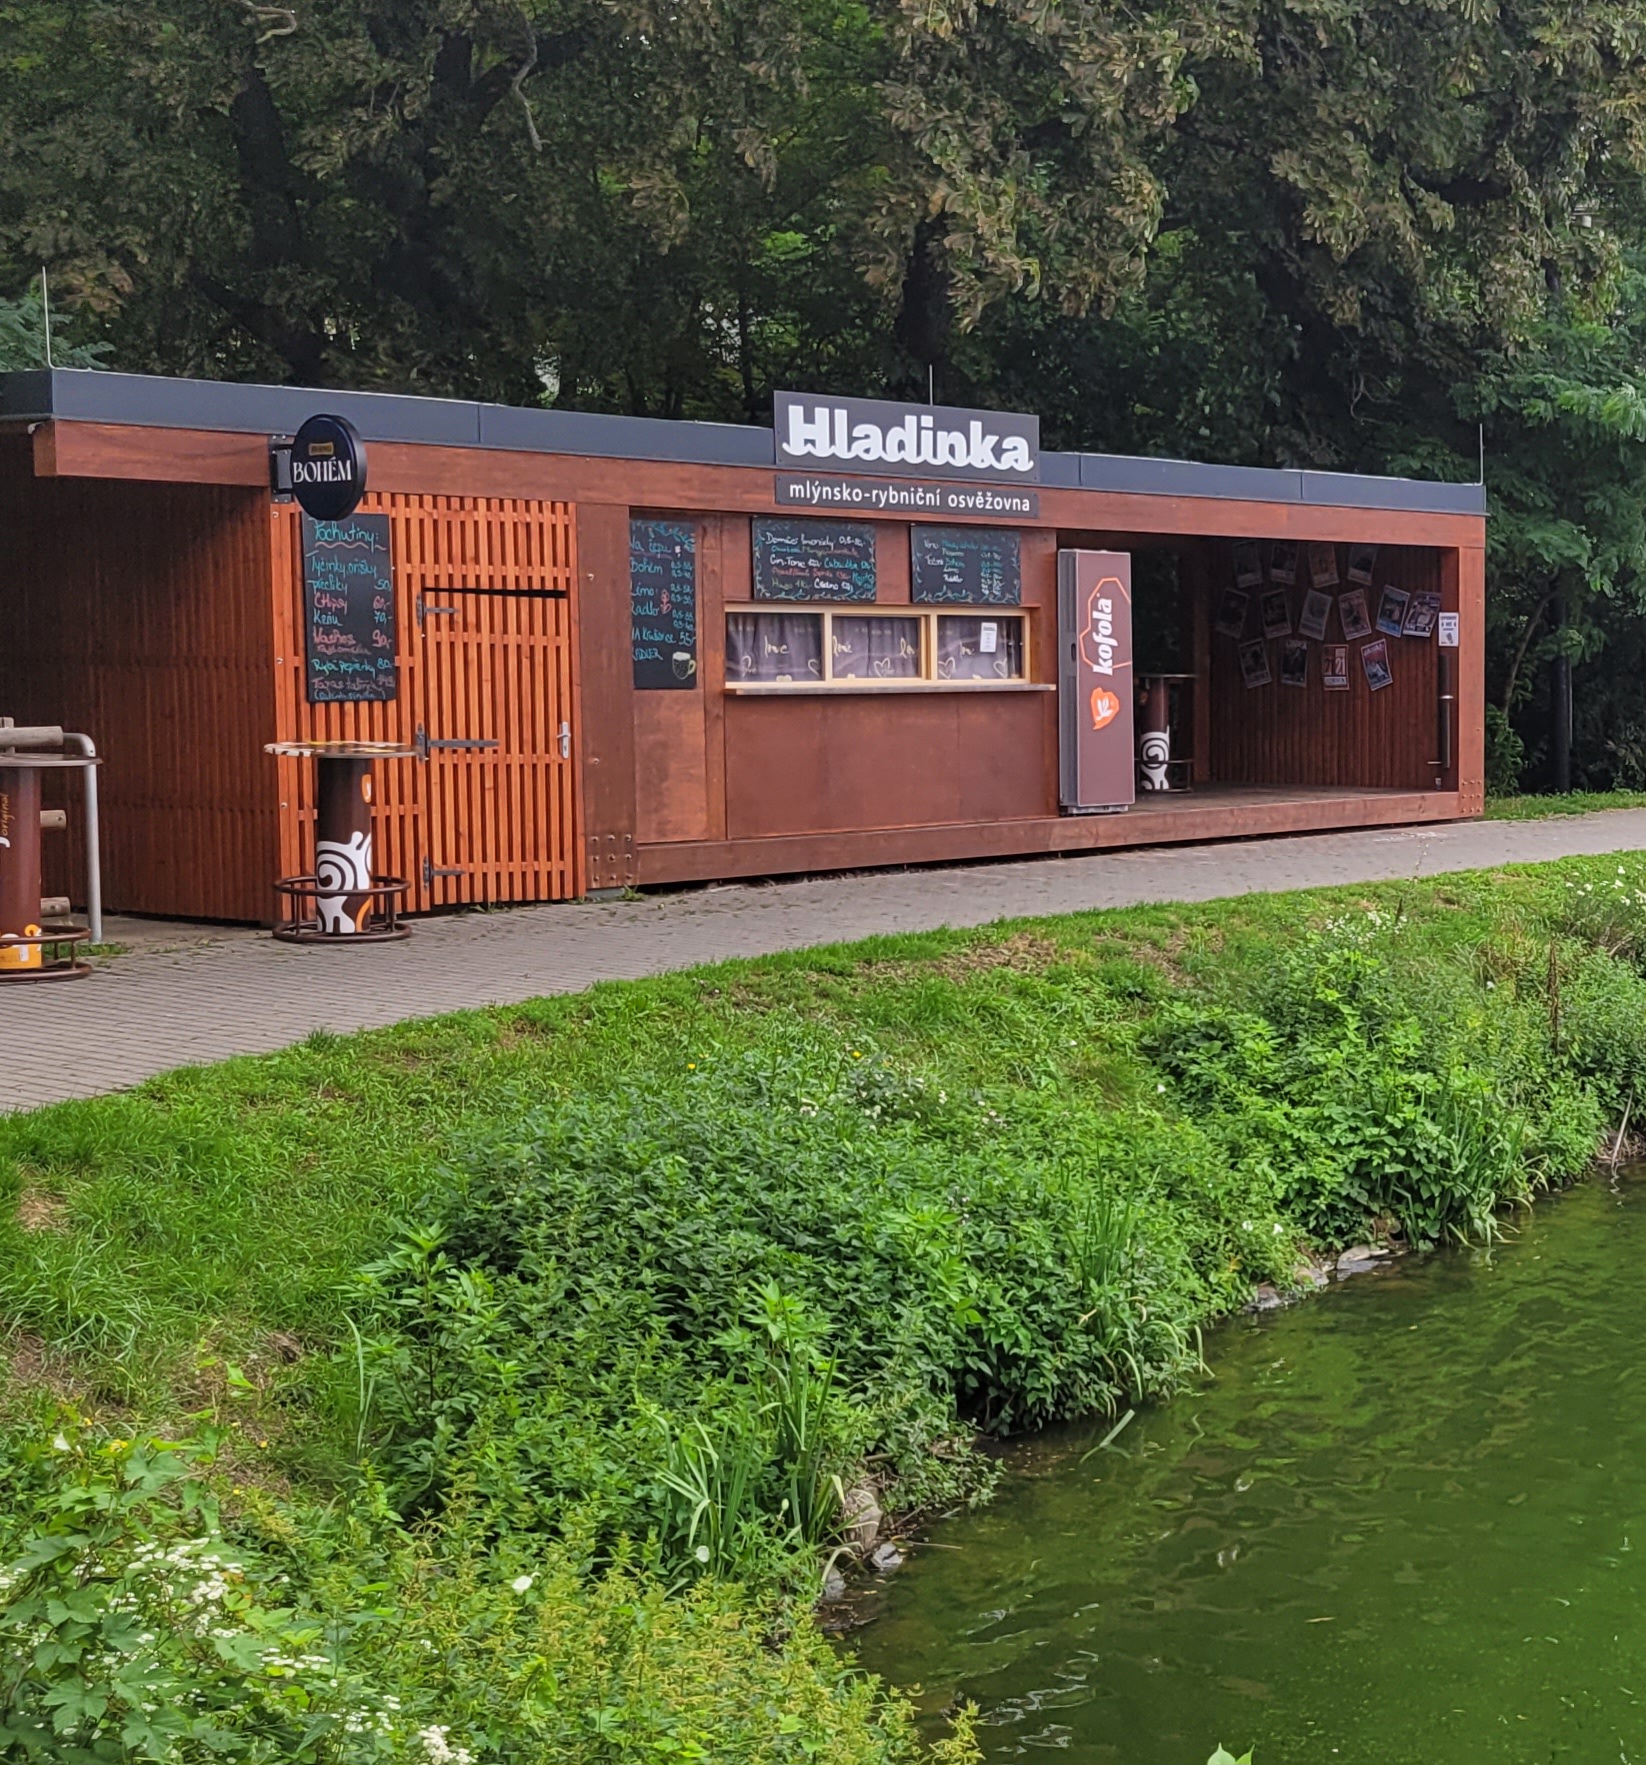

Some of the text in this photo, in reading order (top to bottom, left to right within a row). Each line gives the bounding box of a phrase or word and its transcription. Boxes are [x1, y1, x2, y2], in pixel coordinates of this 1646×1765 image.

[782, 404, 1034, 472] Hladinka
[293, 456, 352, 483] BOHÉM
[789, 479, 1030, 512] mlýnsko-rybniční osvěžovna
[1092, 598, 1119, 676] kofola
